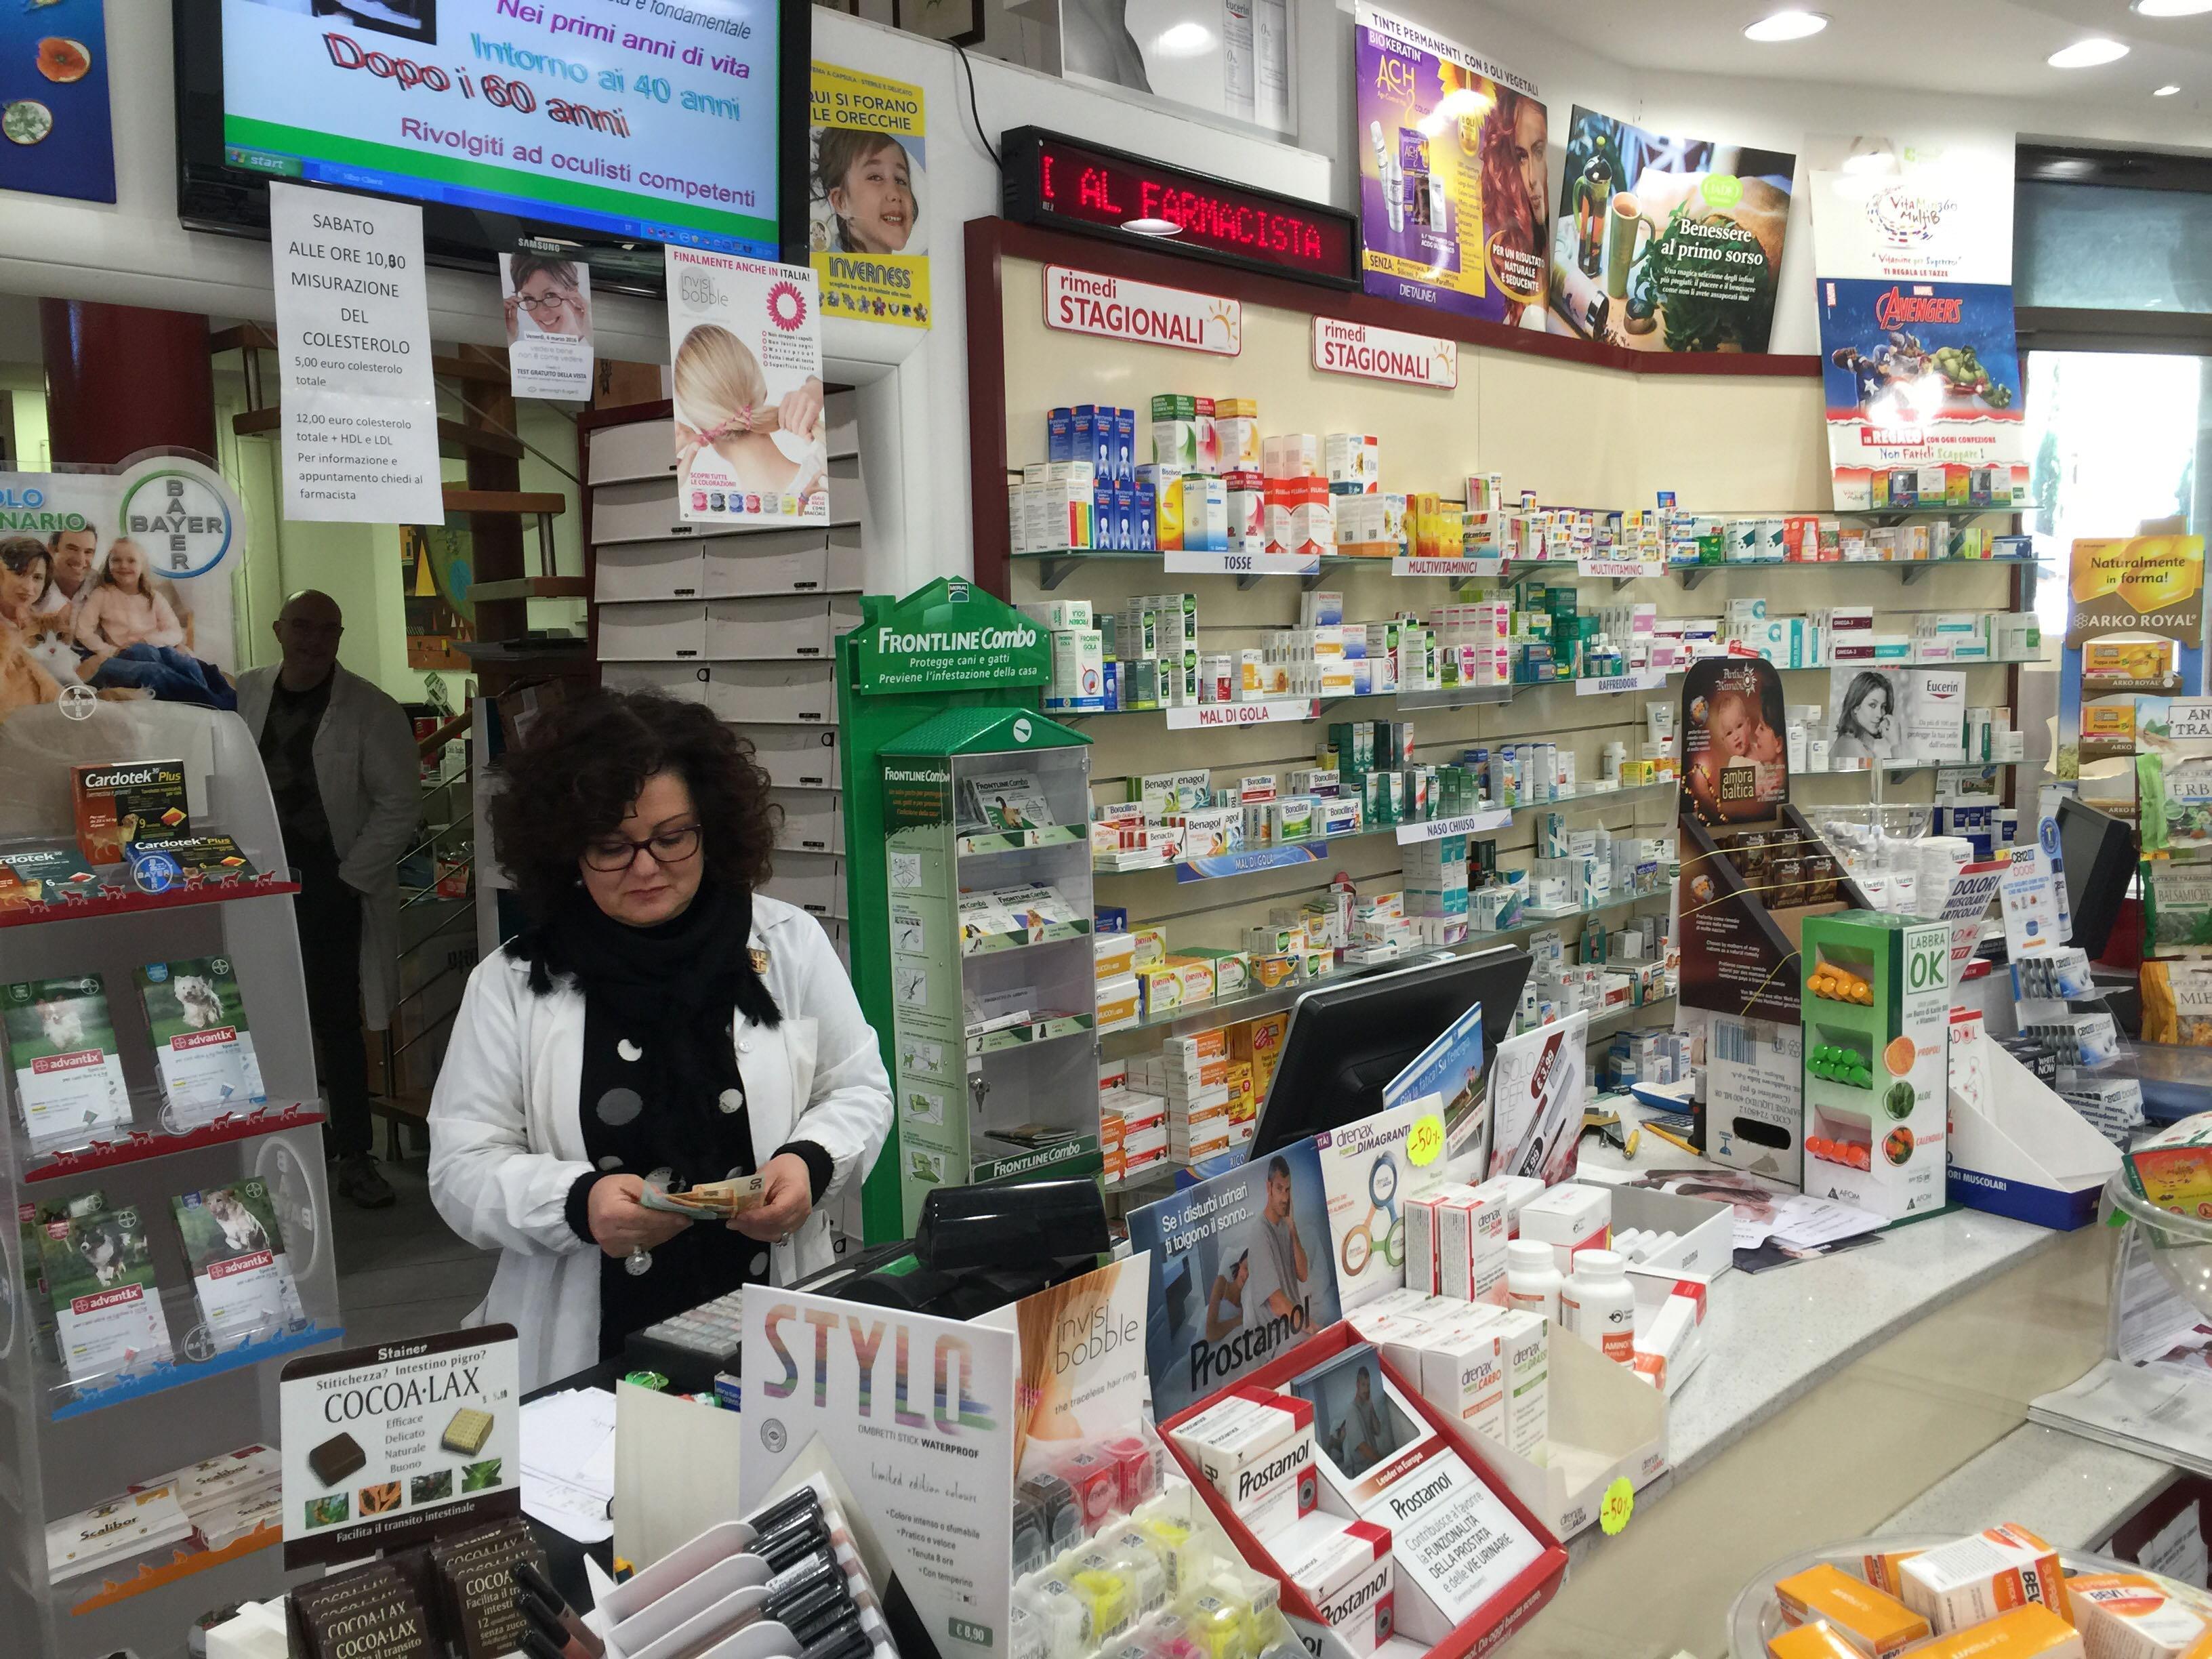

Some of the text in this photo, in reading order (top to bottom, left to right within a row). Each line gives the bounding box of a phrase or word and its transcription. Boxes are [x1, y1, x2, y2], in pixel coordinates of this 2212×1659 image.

[648, 0, 752, 40] fondamentale
[496, 0, 750, 79] Nei primi anni di vita
[1372, 12, 1539, 97] TINTE PERMANENTI CON VEGETALI
[322, 33, 630, 138] Dopo 60 anni
[470, 32, 741, 121] Intorno ai 40 anni
[836, 94, 918, 115] SI FORANO
[813, 108, 912, 130] LE ORECCHIE
[250, 155, 284, 170] start
[401, 117, 755, 208] Rivolgiti ad oculisti competenti
[312, 213, 375, 236] SABATO
[1082, 167, 1322, 260] AL FARMACISTA
[1679, 218, 1752, 243] Benessere
[289, 241, 361, 264] ALLE ORE
[518, 238, 561, 253] SAMSUNG
[1661, 239, 1763, 266] al primo sorso
[674, 251, 766, 275] FINALMENTE ANCHE
[829, 256, 912, 289] INVERNESS
[1504, 261, 1536, 279] NATURALE
[291, 272, 400, 298] MISURAZIONE
[1060, 272, 1117, 298] rimedi
[1399, 283, 1437, 304] DIETALINEA
[1506, 274, 1539, 293] SEDUCENTE
[341, 308, 369, 324] DEL
[1876, 285, 1963, 330] AVENGERS
[1059, 294, 1204, 346] STAGIONALI
[1324, 321, 1366, 342] rimedi
[302, 331, 411, 355] COLESTEROLO
[348, 361, 403, 375] colesterolo
[1324, 342, 1430, 380] STAGIONALI
[295, 375, 327, 387] totale
[356, 417, 411, 430] colesterolo
[296, 432, 329, 443] totale
[318, 453, 389, 466] informazione
[299, 472, 379, 485] appuntamento
[300, 489, 356, 501] farmacista
[130, 514, 224, 534] BAYER
[166, 479, 190, 570] BAYER
[1225, 556, 1252, 571] TOSSE
[1408, 561, 1477, 575] MULTIVITAMINICI
[1590, 563, 1643, 576] MULTIVITAMINICI
[2090, 555, 2185, 571] Naturalmente
[2121, 571, 2169, 586] forma!
[2089, 612, 2196, 628] ARKO ROYAL
[878, 623, 1036, 654] FRONTLINE Combo
[910, 654, 1010, 670] Protegge cani gatti
[879, 667, 1038, 684] Previene l'infestazione della casa
[1598, 677, 1638, 691] RAFFREDDORE
[1927, 680, 1959, 694] Eucerin
[1200, 707, 1269, 725] MAL GOLA
[85, 769, 182, 788] Cardotek Plus
[1723, 770, 1753, 785] ambra
[1722, 783, 1755, 800] baltica
[1189, 819, 1221, 832] Benagol
[1427, 819, 1475, 837] NASO CHIUSO
[135, 838, 201, 851] Cardotek
[1952, 874, 2002, 897] DOLORI
[1940, 905, 1985, 920] ARTICOLARI
[1910, 934, 1946, 947] LABBRA
[1910, 951, 1945, 988] OK
[51, 1053, 100, 1070] advantix
[1502, 1052, 1536, 1085] SOLO
[2038, 1063, 2056, 1075] NOW
[1336, 1123, 1375, 1147] drenax
[994, 1143, 1081, 1177] FRONTLINE Combo
[1963, 1172, 2007, 1191] MUSCOLARI
[1162, 1181, 1248, 1233] Se disturbi urinari
[1173, 1224, 1210, 1251] tolgono
[90, 1287, 138, 1311] advantix
[1057, 1298, 1109, 1344] invisi
[377, 1342, 428, 1361] Stainer
[1056, 1313, 1139, 1375] bobble
[1191, 1295, 1311, 1392] Prostamol
[1513, 1342, 1541, 1366] drenax
[316, 1349, 487, 1391] Stitichezza? Intestino pigro?
[763, 1304, 998, 1437] STYLO
[1478, 1369, 1502, 1392] CARBO
[1070, 1370, 1137, 1409] traceless ring
[386, 1414, 424, 1429] Efficace
[384, 1428, 425, 1445] Delicato
[858, 1425, 979, 1459] OMBRETTI STICK WATERPROOF
[384, 1443, 426, 1460] Naturale
[196, 1460, 249, 1486] Scalibor
[390, 1459, 422, 1474] Buono
[1238, 1438, 1311, 1502] Prostamol
[871, 1462, 940, 1495] limited edition
[1389, 1471, 1453, 1521] Prostamol
[79, 1515, 139, 1542] Scalibor
[337, 1506, 475, 1543] Facilita transito intestinale
[1405, 1513, 1454, 1551] Contribuisce
[1424, 1512, 1480, 1559] FUNZIONALITÀ
[1453, 1526, 1493, 1560] PROSTATA
[964, 1625, 985, 1643] 8,90
